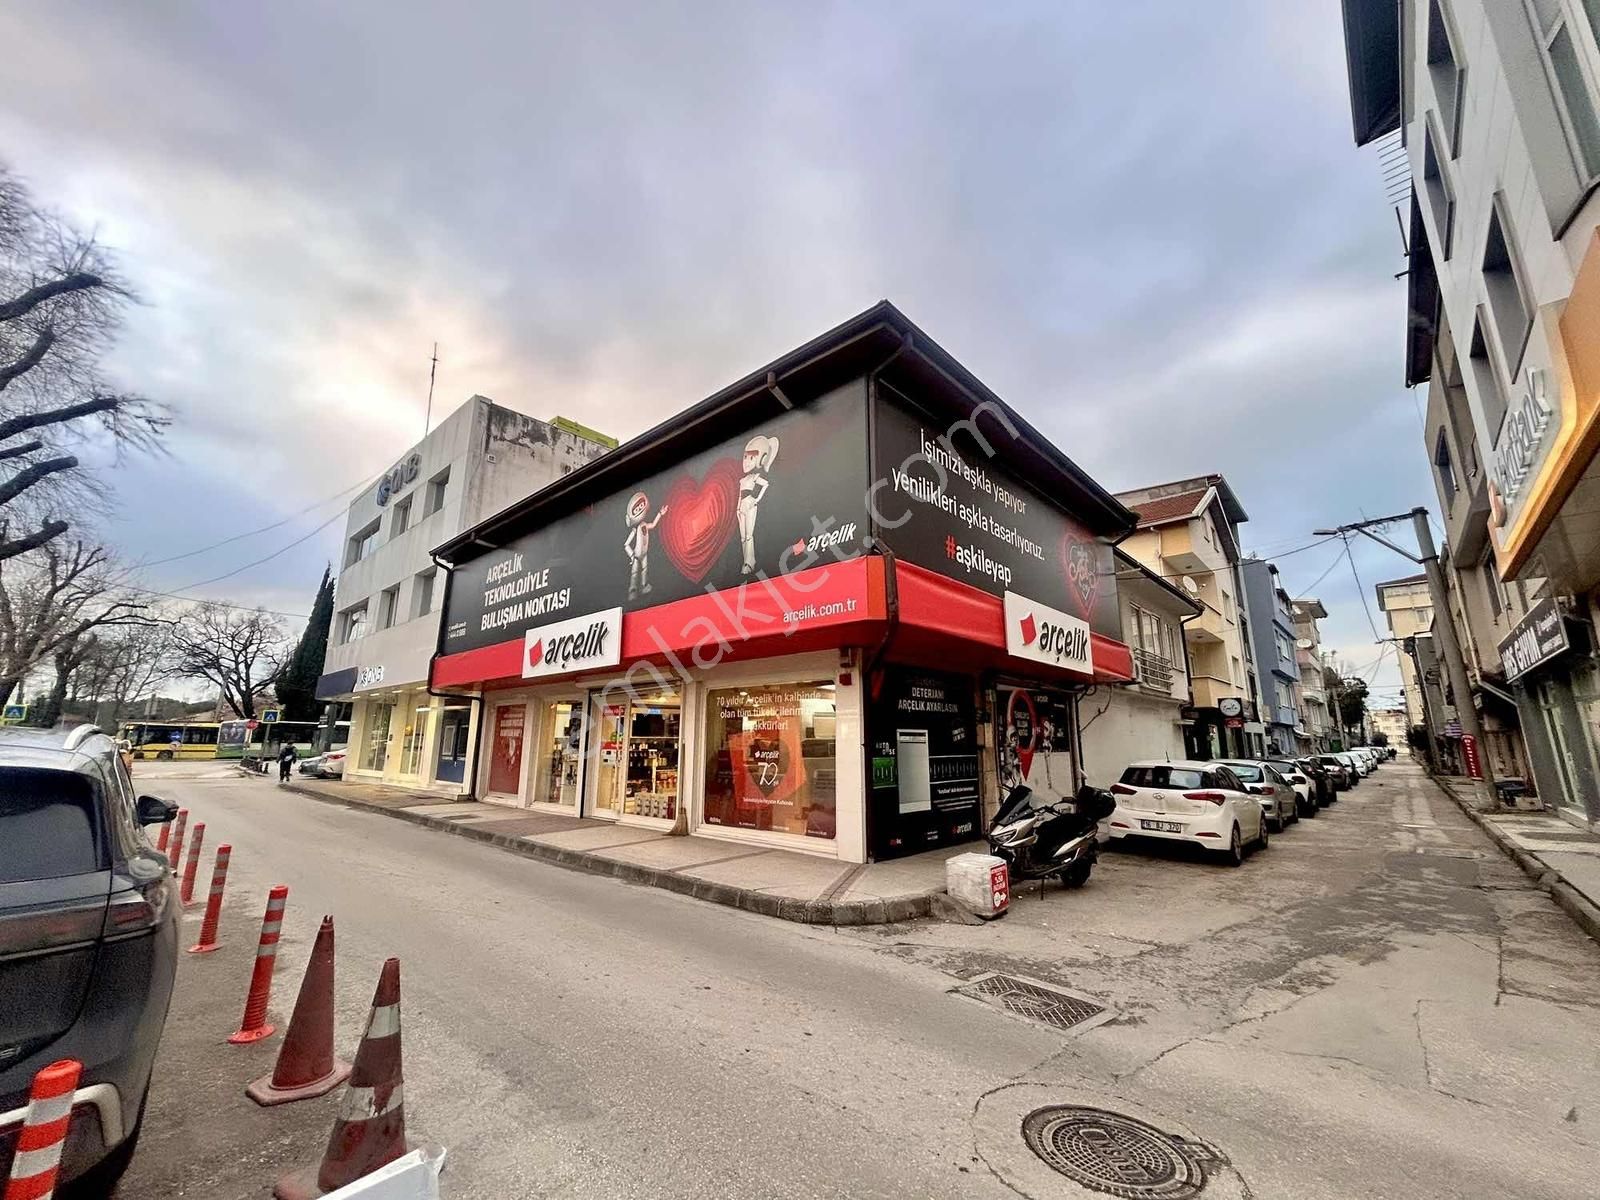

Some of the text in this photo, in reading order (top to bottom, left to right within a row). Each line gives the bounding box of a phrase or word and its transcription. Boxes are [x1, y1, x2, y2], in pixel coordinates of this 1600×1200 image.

[920, 428, 1026, 514] İşimizi aşkla yapıyor
[891, 468, 1045, 560] yenilikleri aşkla tasarlıyoruz.
[806, 522, 857, 552] arçelik
[486, 553, 523, 584] ARÇELİK
[945, 534, 1012, 587] #aşkileyap
[484, 568, 550, 607] TEKNOLOJİYLE
[481, 603, 523, 631] BULUŞMA
[524, 588, 570, 618] NOKTASI
[783, 598, 857, 623] arcelik.com.tr
[544, 621, 608, 670] arçelik
[1040, 621, 1088, 663] arçelik
[720, 709, 735, 718] olan
